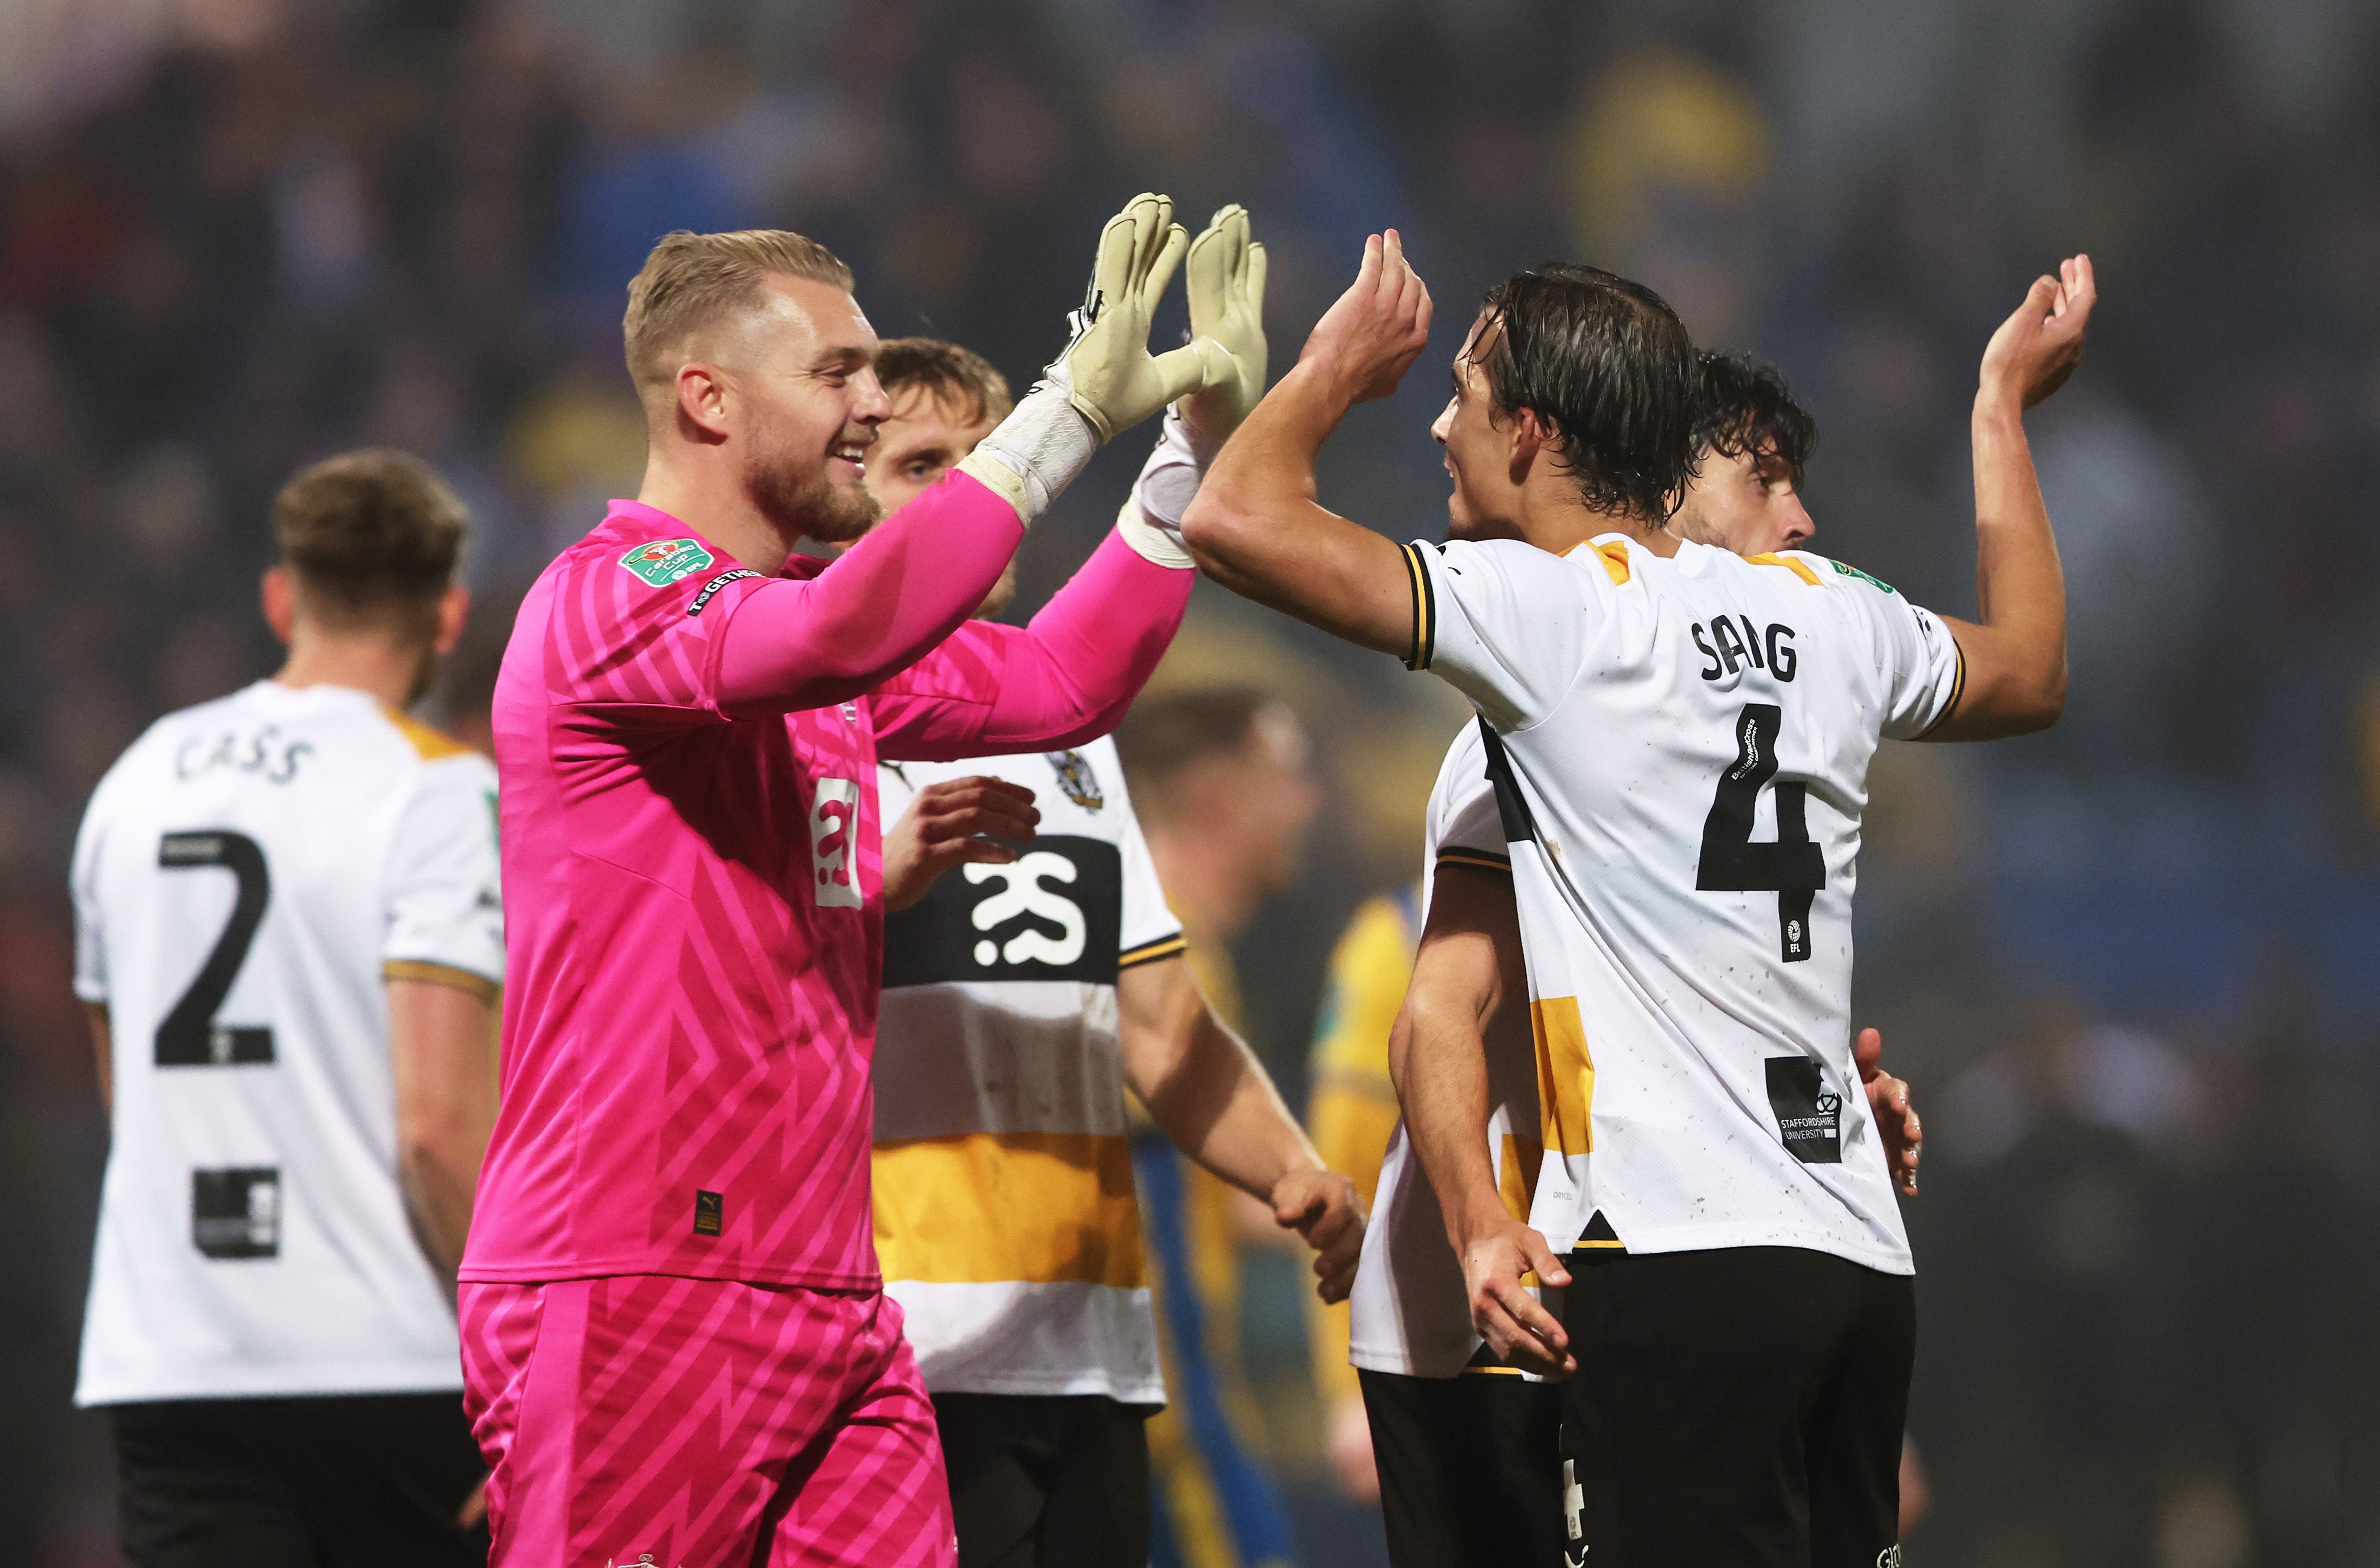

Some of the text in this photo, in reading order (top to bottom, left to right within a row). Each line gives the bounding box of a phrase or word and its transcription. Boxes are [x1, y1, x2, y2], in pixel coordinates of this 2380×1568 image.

[663, 554, 689, 570] Cup
[1696, 703, 1826, 963] 4
[155, 831, 274, 1065] 2
[1790, 943, 1801, 953] EFL
[1781, 1117, 1836, 1129] STAFFORDSHIRE
[1785, 1129, 1823, 1140] UNIVERSITY
